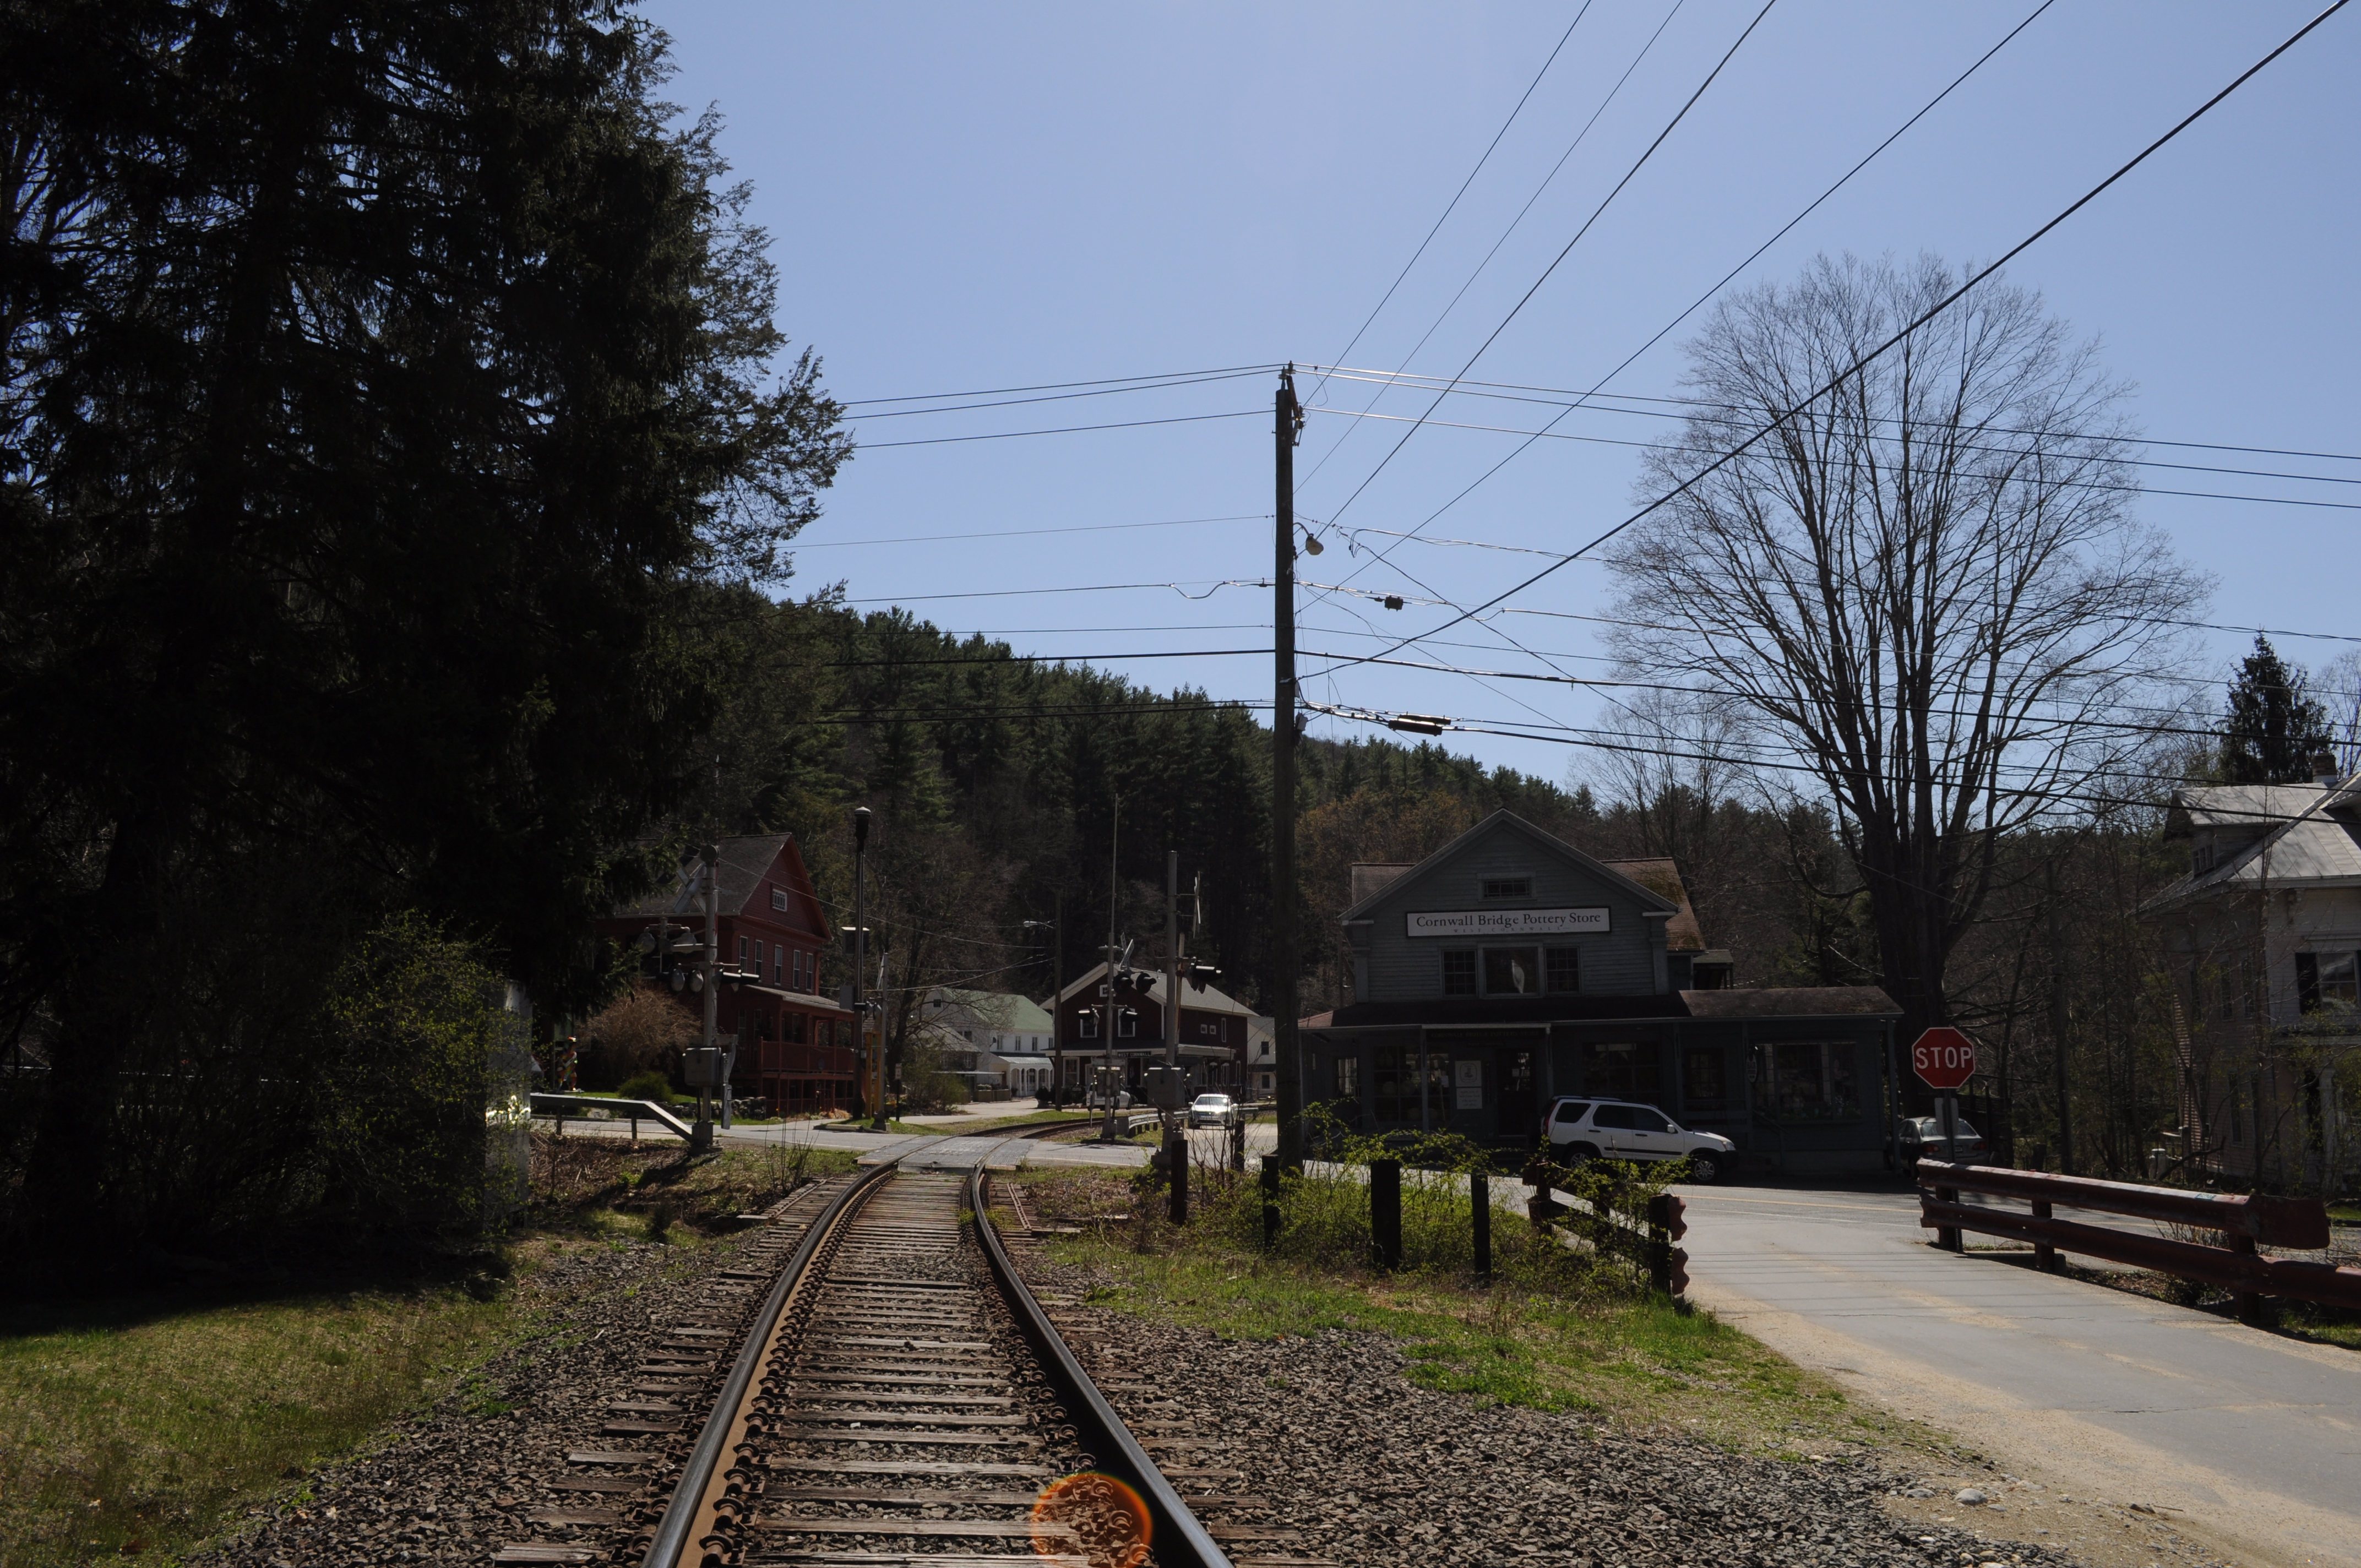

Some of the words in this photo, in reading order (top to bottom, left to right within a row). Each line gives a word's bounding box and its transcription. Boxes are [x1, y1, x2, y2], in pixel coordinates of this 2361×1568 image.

[1417, 915, 1473, 927] Cornwall
[1478, 914, 1519, 928] Bridge
[1523, 914, 1566, 927] Pottery
[1569, 912, 1600, 923] Store
[1916, 1047, 1972, 1069] STOP
